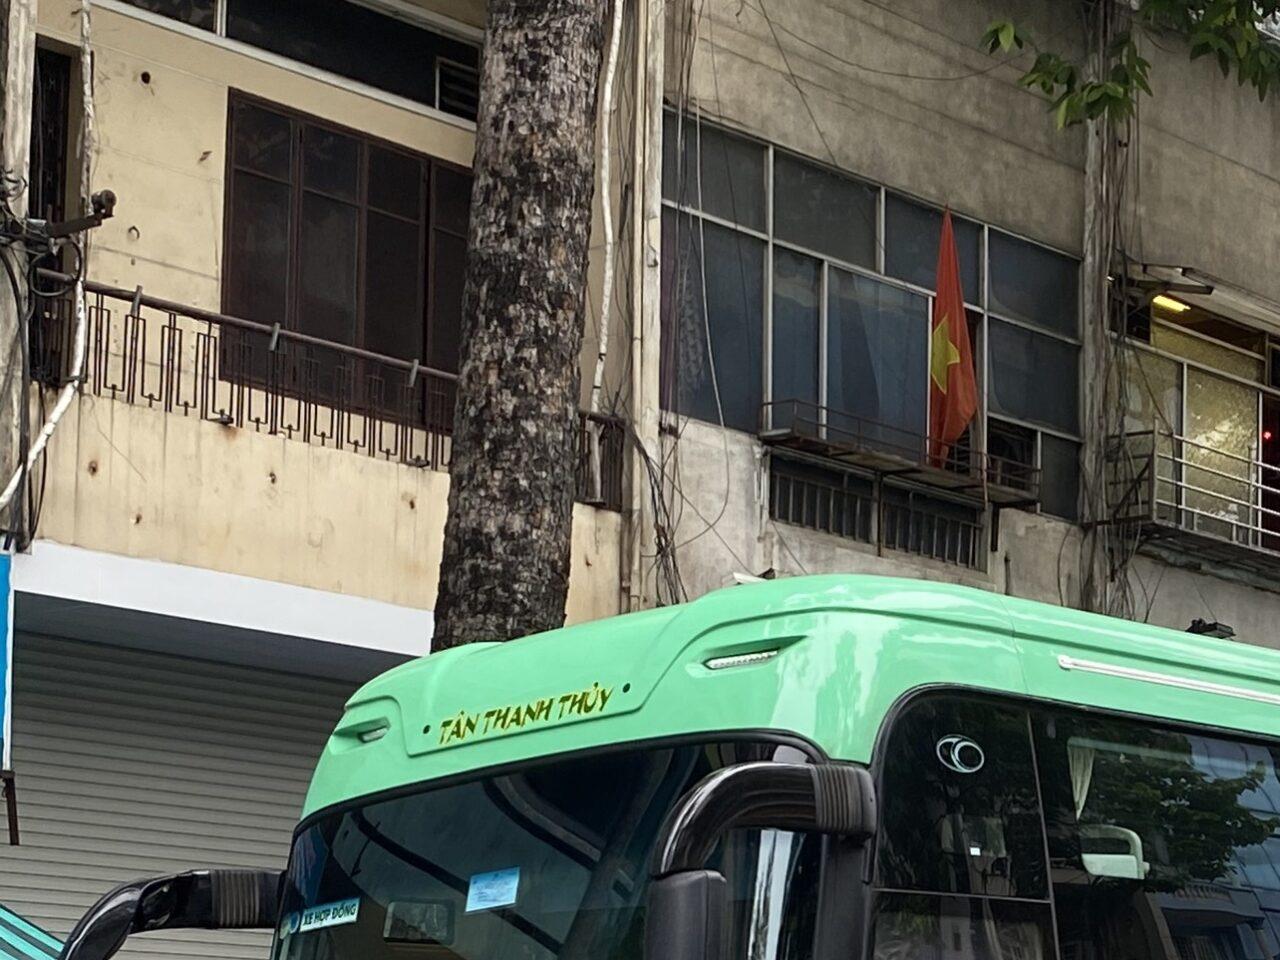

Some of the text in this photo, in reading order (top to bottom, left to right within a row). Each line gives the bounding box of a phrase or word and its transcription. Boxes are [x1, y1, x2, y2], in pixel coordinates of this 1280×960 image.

[483, 698, 554, 735] THANH
[558, 682, 614, 720] THỦY
[303, 912, 314, 925] XE
